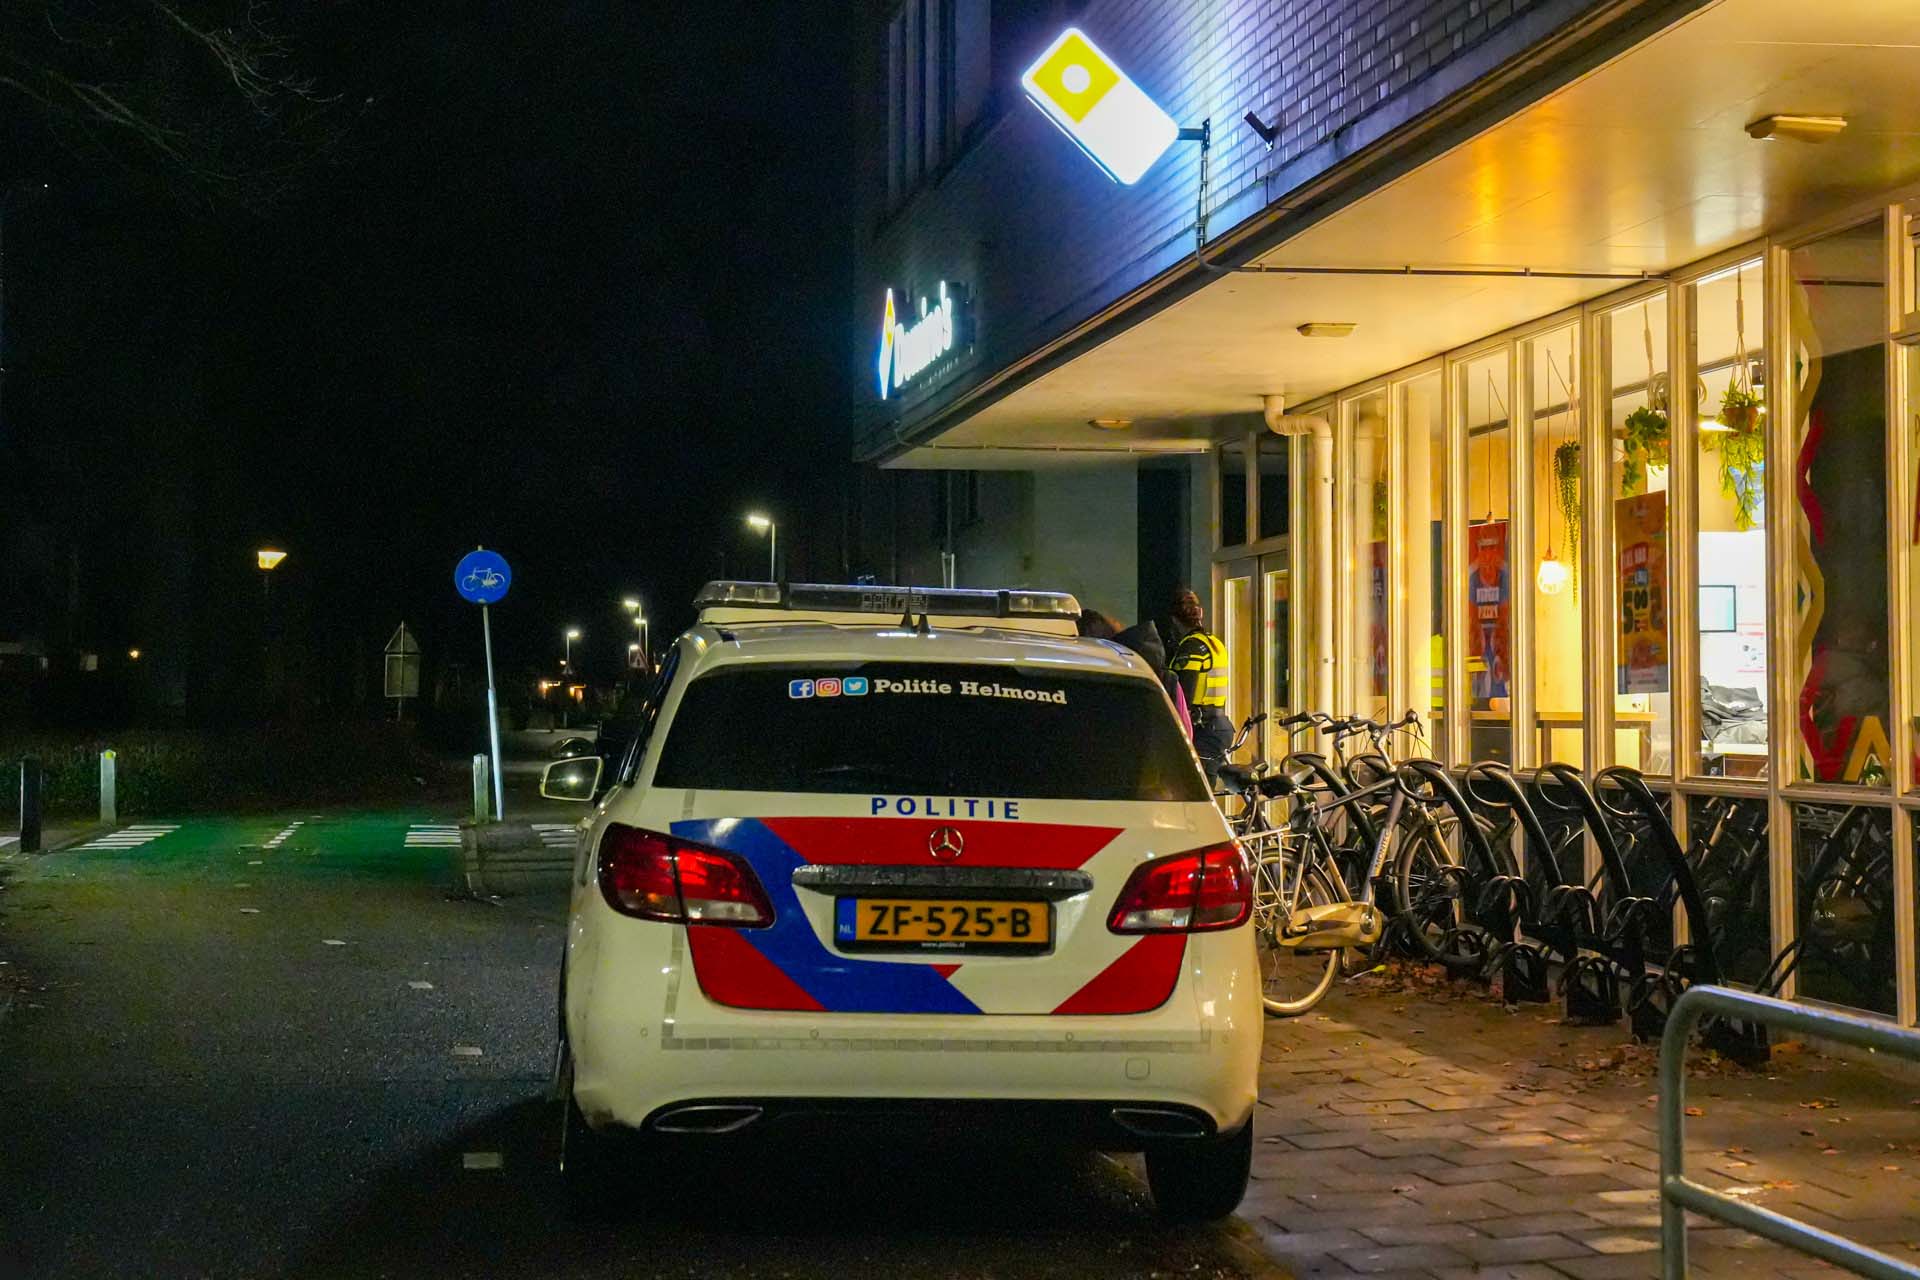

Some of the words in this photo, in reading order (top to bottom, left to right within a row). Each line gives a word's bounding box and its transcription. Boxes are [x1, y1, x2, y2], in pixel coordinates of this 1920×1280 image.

[874, 678, 952, 695] Politie
[960, 681, 1068, 705] Helmond
[871, 797, 1020, 820] POLITIE
[839, 924, 853, 934] NL
[868, 905, 1032, 938] ZF-525-B
